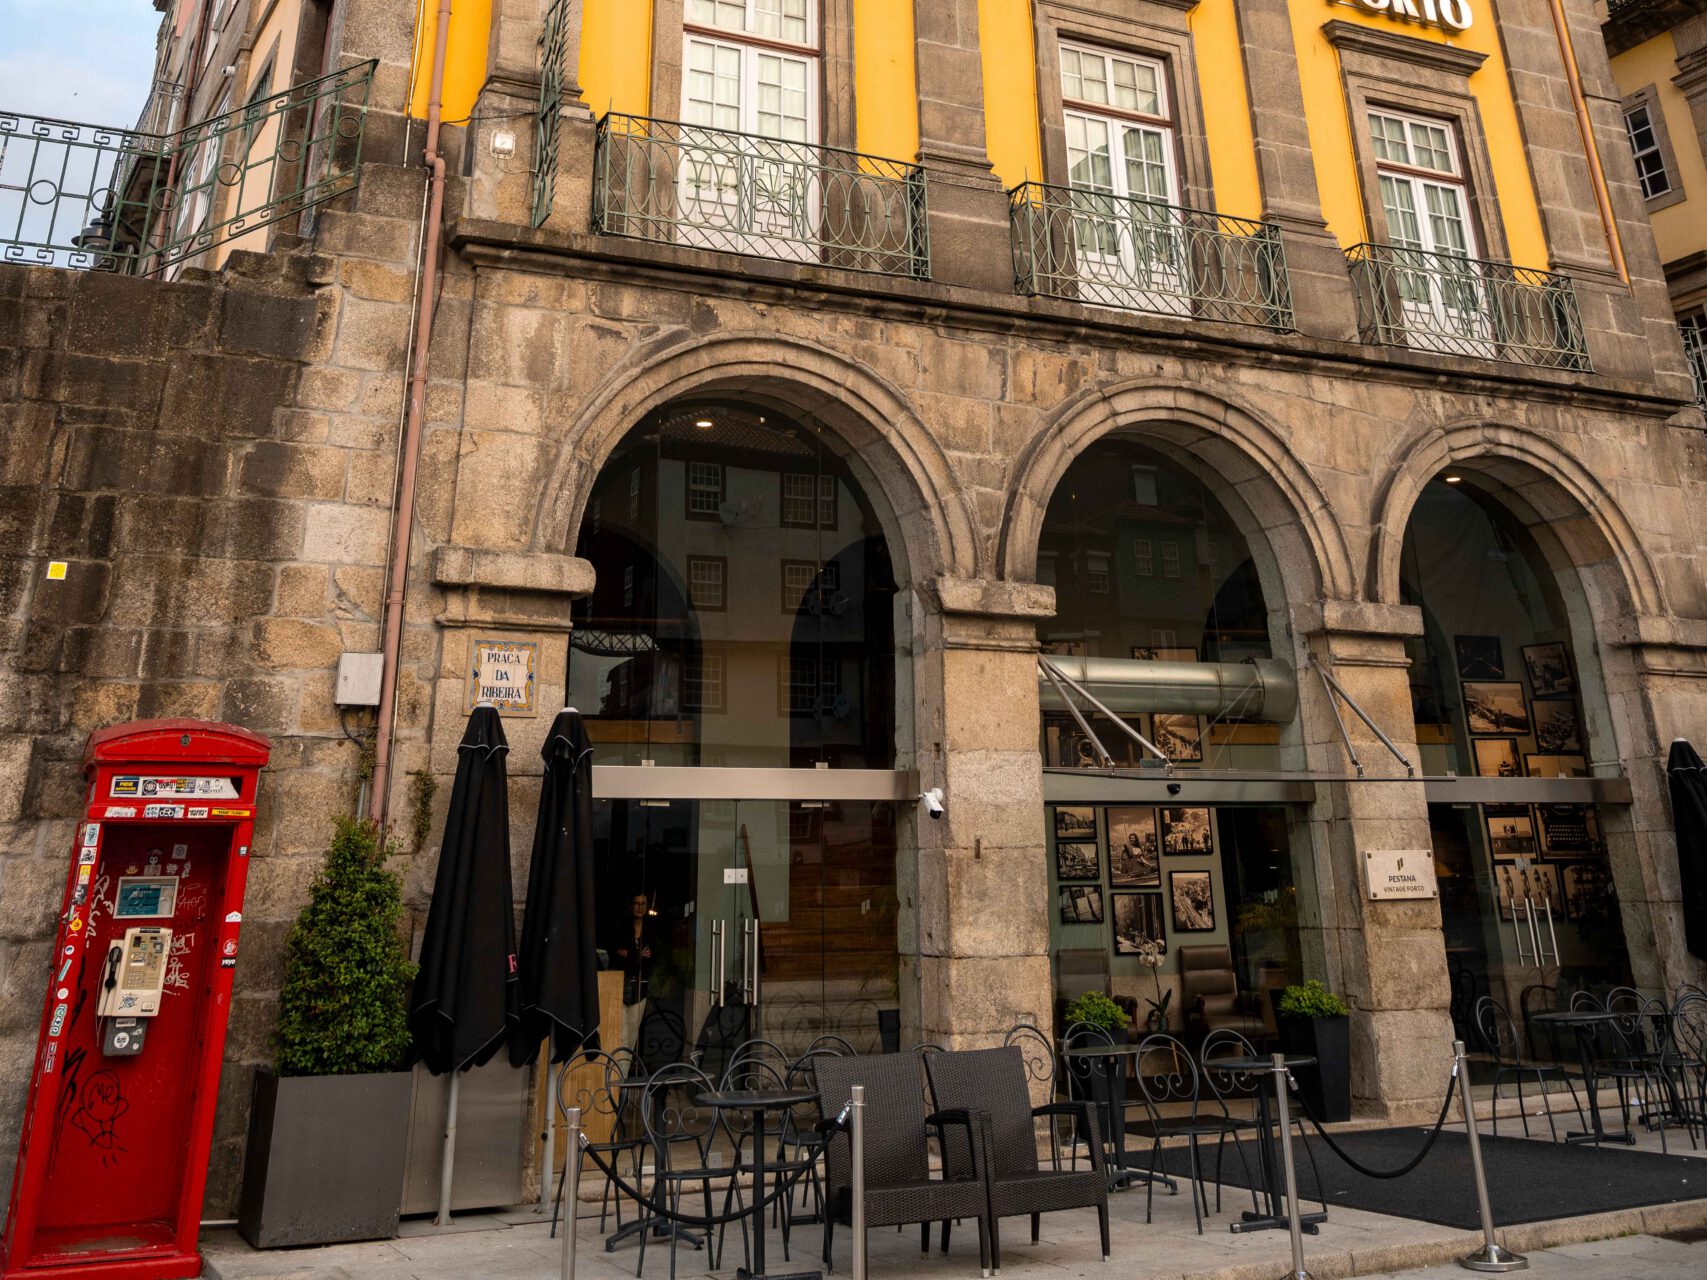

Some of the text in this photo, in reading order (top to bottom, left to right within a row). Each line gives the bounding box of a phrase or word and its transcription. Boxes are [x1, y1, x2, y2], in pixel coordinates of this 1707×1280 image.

[487, 652, 521, 664] PRAÇA
[495, 669, 509, 681] DA
[481, 686, 521, 699] RIBEIRA
[1388, 875, 1416, 883] PESTANA
